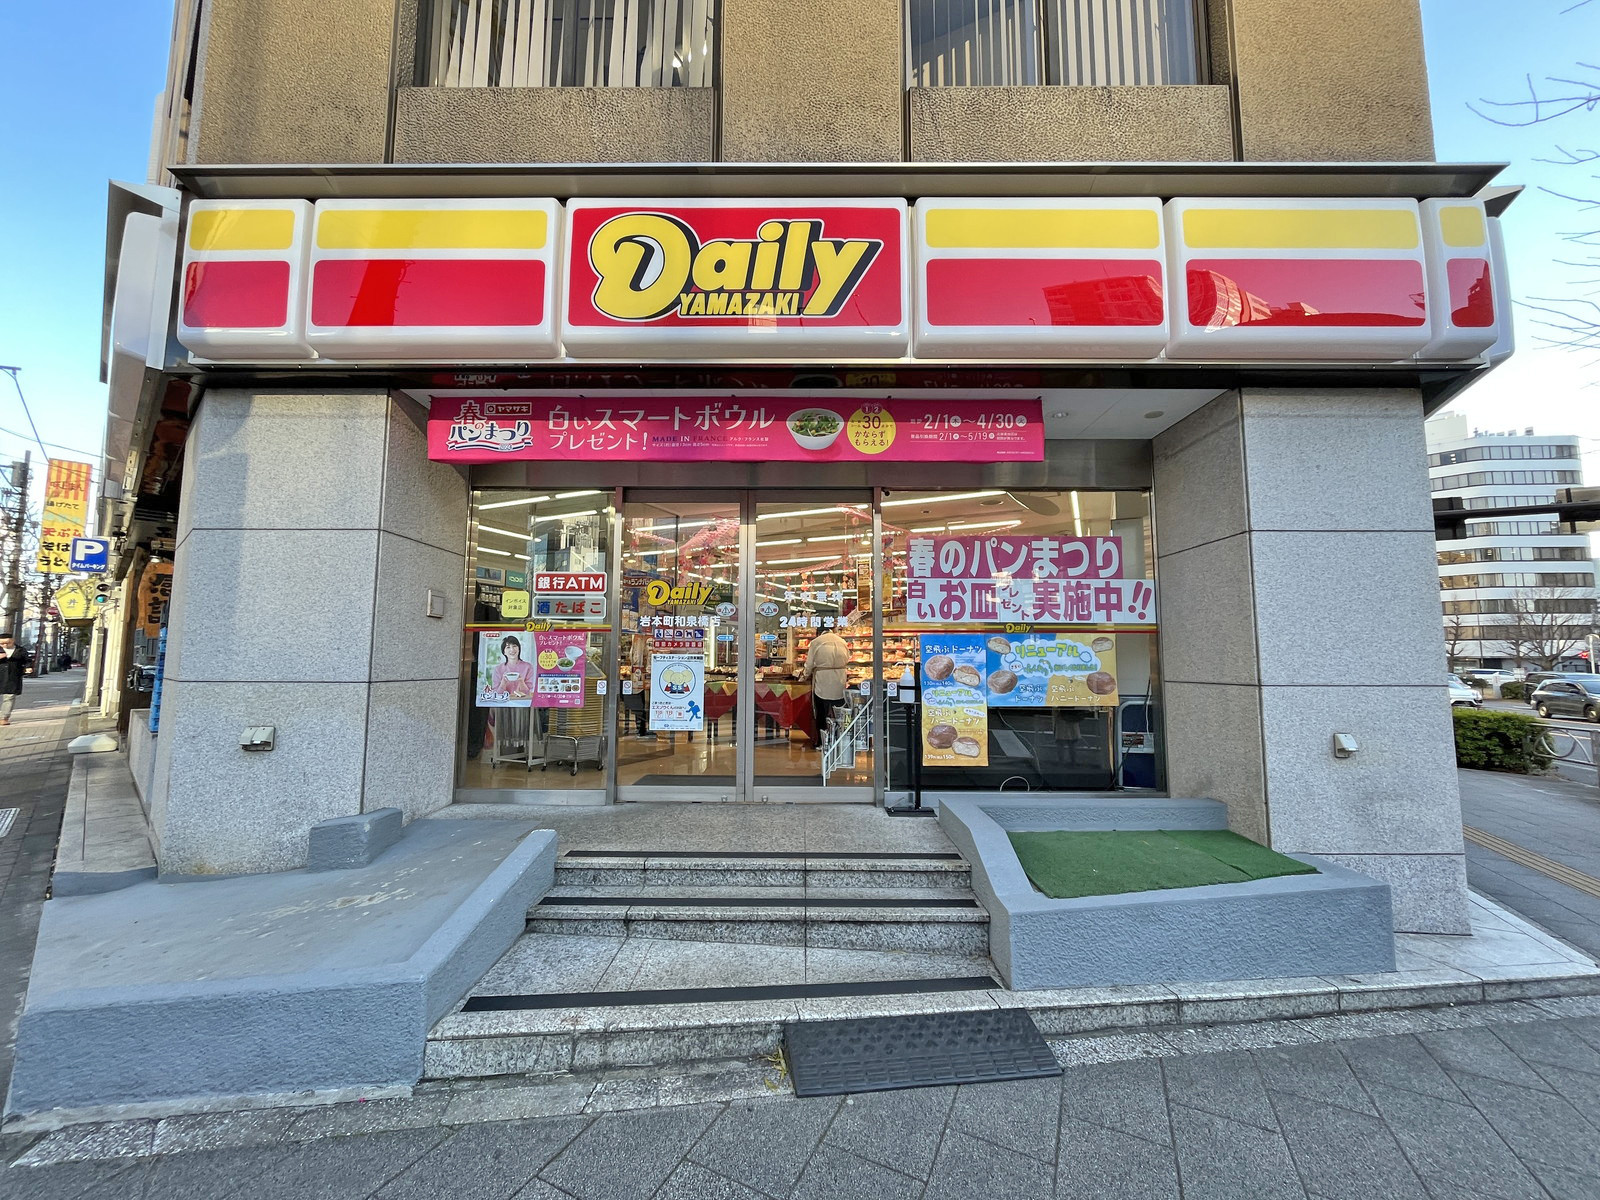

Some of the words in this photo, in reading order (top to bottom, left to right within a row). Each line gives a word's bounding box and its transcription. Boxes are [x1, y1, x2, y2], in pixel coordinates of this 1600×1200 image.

[590, 213, 883, 319] Daily
[679, 293, 803, 315] YAMAZAKI
[548, 403, 776, 431] 白いスマートボウル
[862, 416, 881, 429] 30
[549, 431, 648, 450] プレゼント!
[75, 541, 104, 561] P
[909, 537, 1120, 578] 春のパンまつり
[71, 562, 106, 570] タイムパーキング
[537, 576, 603, 590] 銀行ATM
[646, 580, 714, 606] Daily
[537, 601, 551, 614] 酒
[555, 601, 602, 613] たばこ
[525, 621, 552, 632] Daily
[640, 615, 721, 628] 岩本町和泉橋店
[779, 616, 848, 628] 24時間営業
[1006, 623, 1031, 633] Daily
[925, 644, 983, 654] 空飛ぶドーナツ
[1015, 643, 1081, 659] リニューアル
